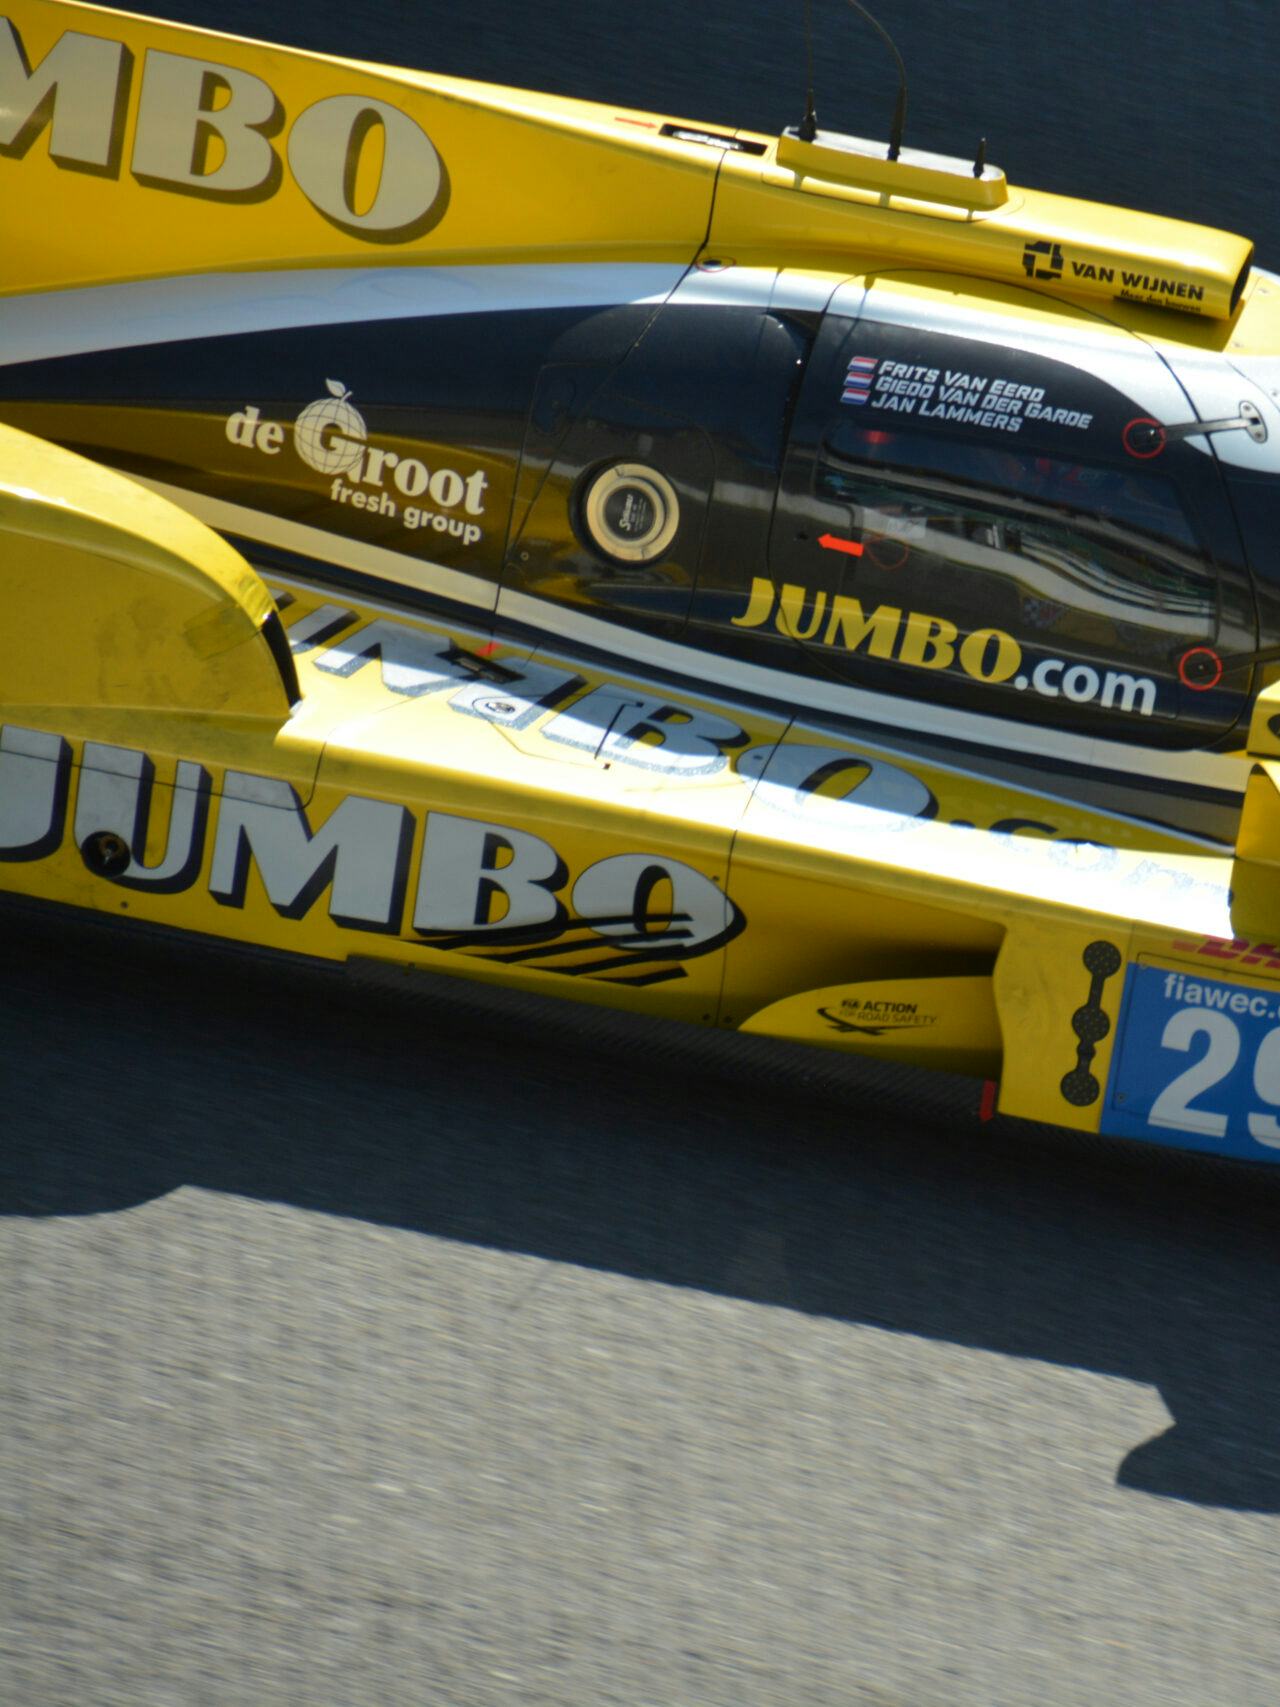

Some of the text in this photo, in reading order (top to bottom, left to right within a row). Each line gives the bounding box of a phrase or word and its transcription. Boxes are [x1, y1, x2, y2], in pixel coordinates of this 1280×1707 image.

[1071, 261, 1205, 301] VAN WIJNEN
[878, 360, 1046, 401] FRITS VAN EERD
[871, 394, 1023, 432] JAN LAMMERS
[875, 376, 1093, 429] GIEDO VAN DER GARDE
[225, 398, 489, 516] de Groot
[330, 478, 482, 546] fresh group
[730, 577, 1157, 717] JUMBO.com
[857, 1011, 890, 1023] ROAD
[893, 1014, 938, 1025] SAFETY
[863, 1001, 918, 1014] ACTION
